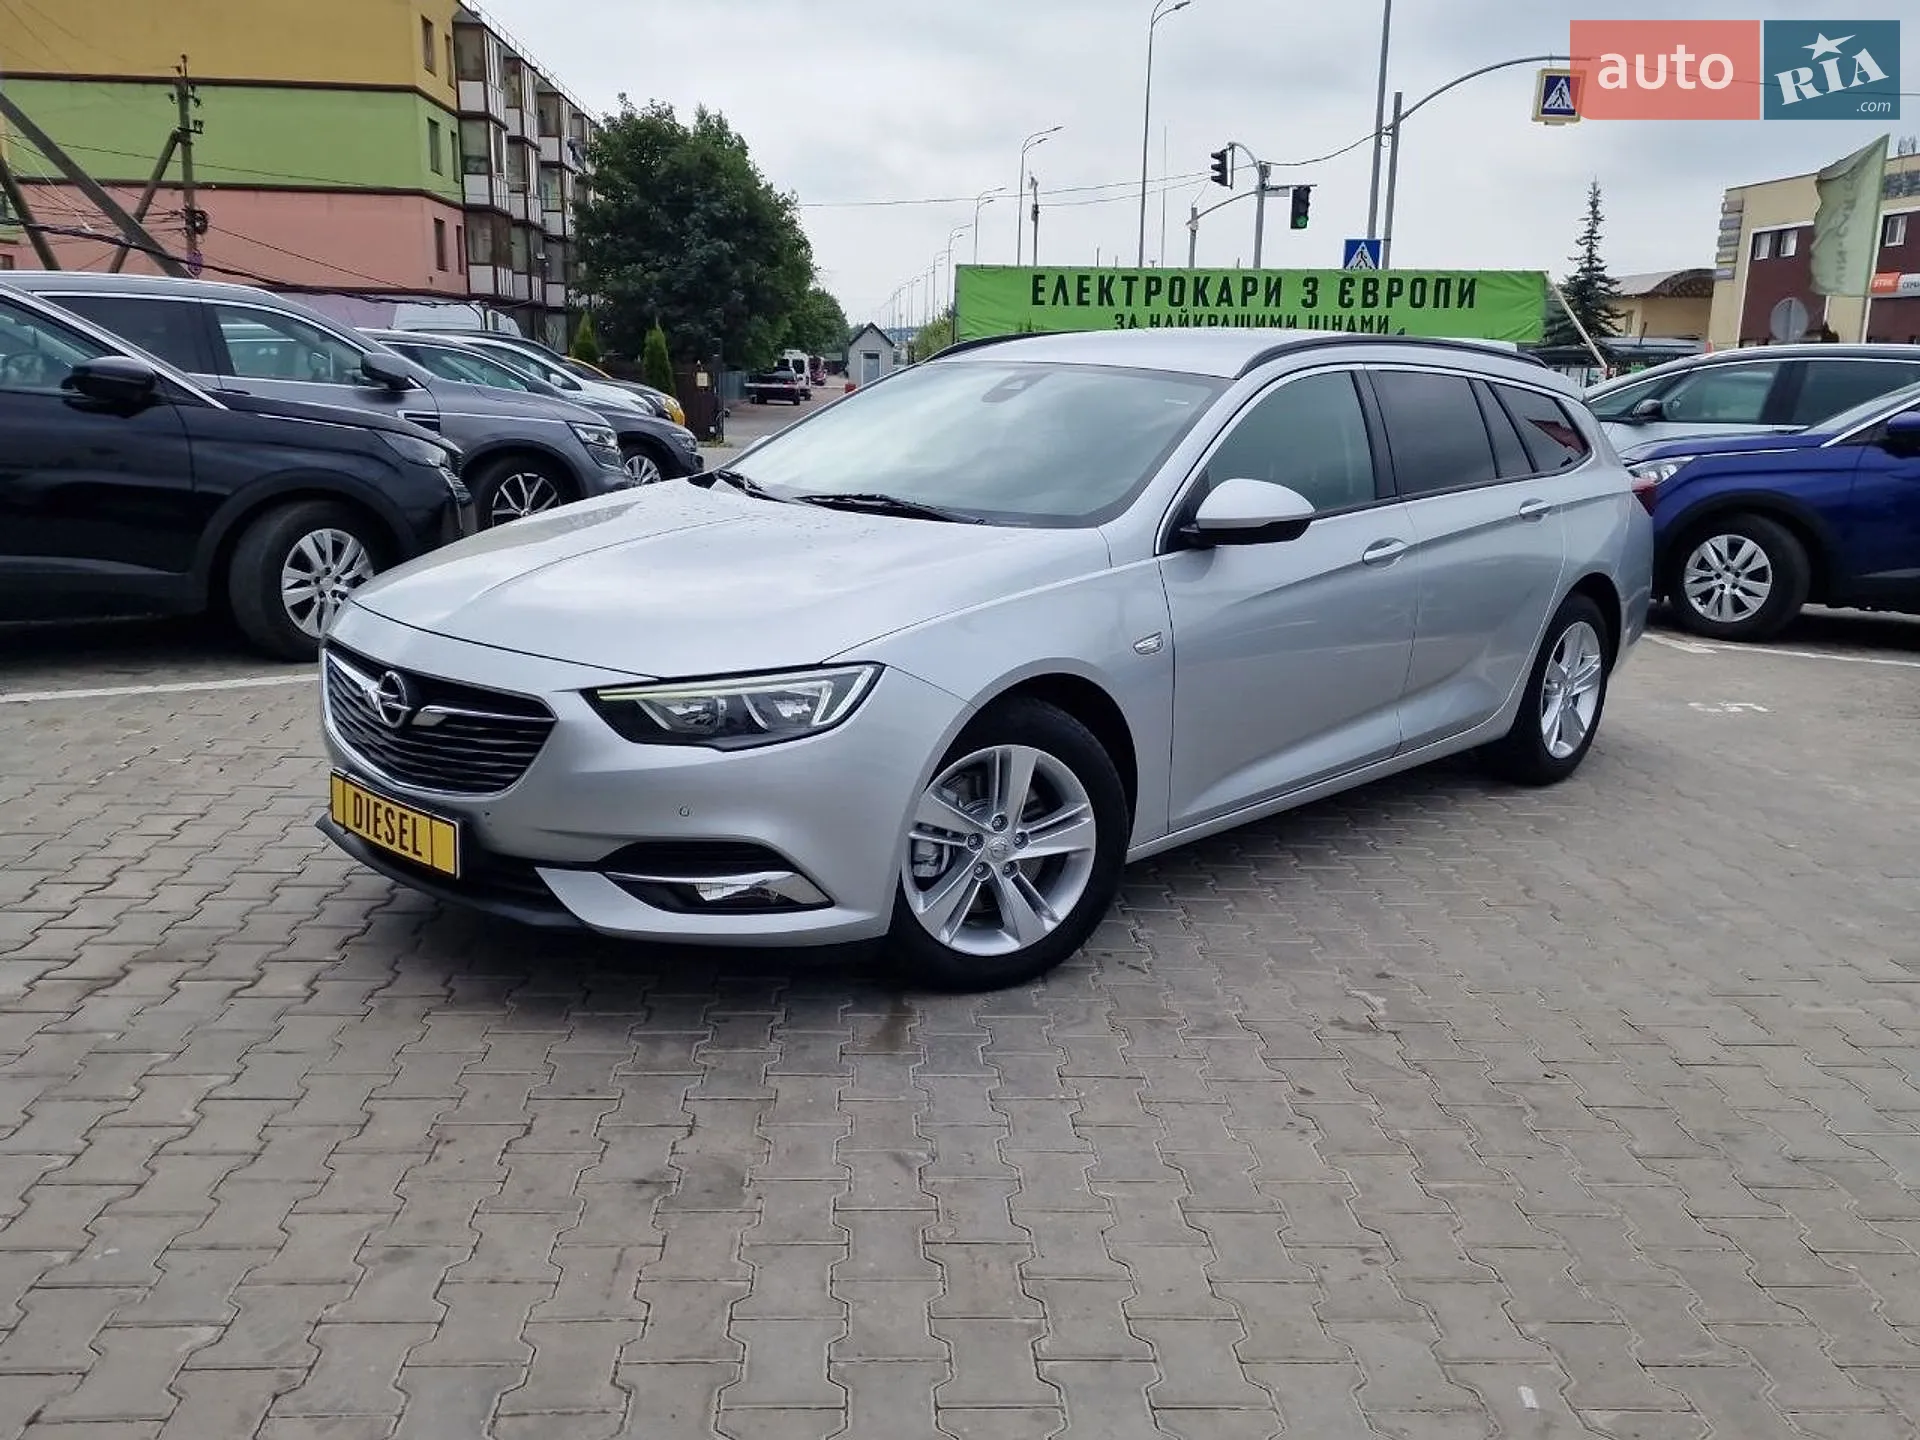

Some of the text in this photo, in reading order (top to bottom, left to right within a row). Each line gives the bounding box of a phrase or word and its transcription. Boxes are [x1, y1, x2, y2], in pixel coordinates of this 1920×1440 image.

[1031, 274, 1283, 308] ЕЛЕКТРОКАРИ
[1337, 277, 1478, 309] ЄВРОПИ
[1114, 313, 1138, 330] ЗА
[353, 792, 423, 857] DIESEL
